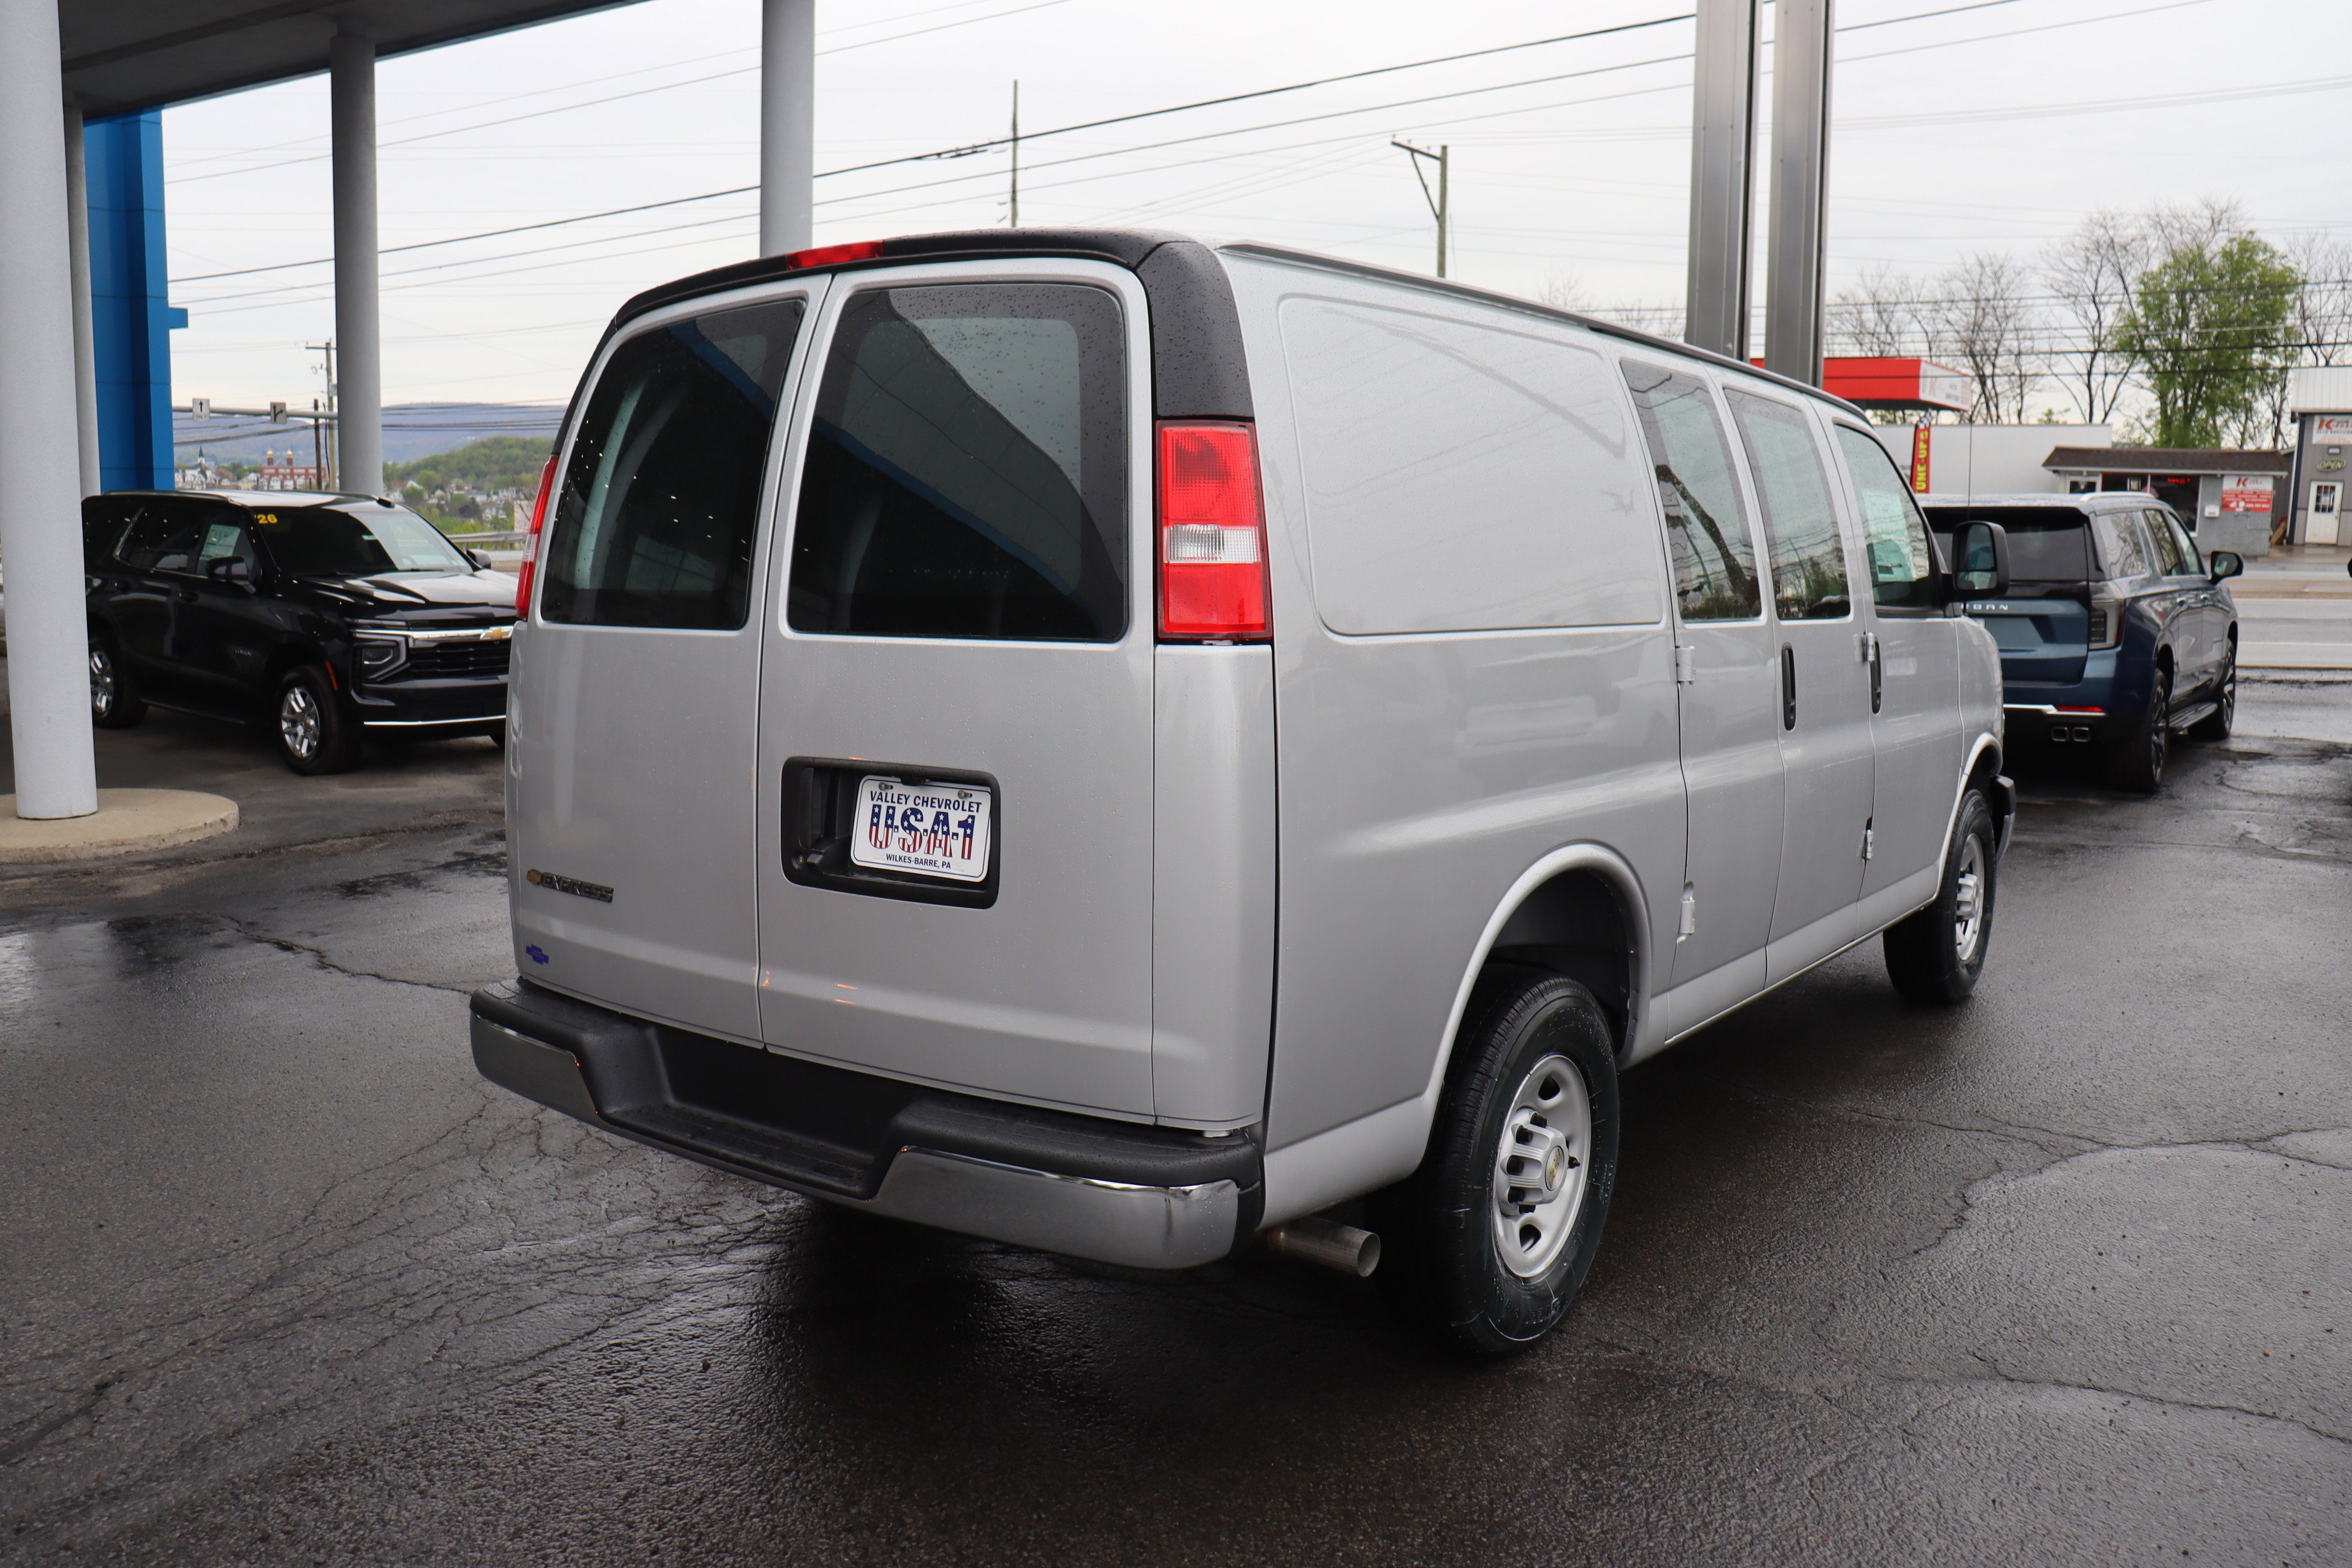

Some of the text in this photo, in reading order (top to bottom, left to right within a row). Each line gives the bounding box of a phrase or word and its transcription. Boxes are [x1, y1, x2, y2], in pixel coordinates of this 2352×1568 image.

[2319, 461, 2343, 469] OPEN
[870, 791, 982, 813] VALLEY CHEVROLET
[886, 853, 940, 869] WILKES-BARRE,
[541, 873, 613, 902] EXPRESS
